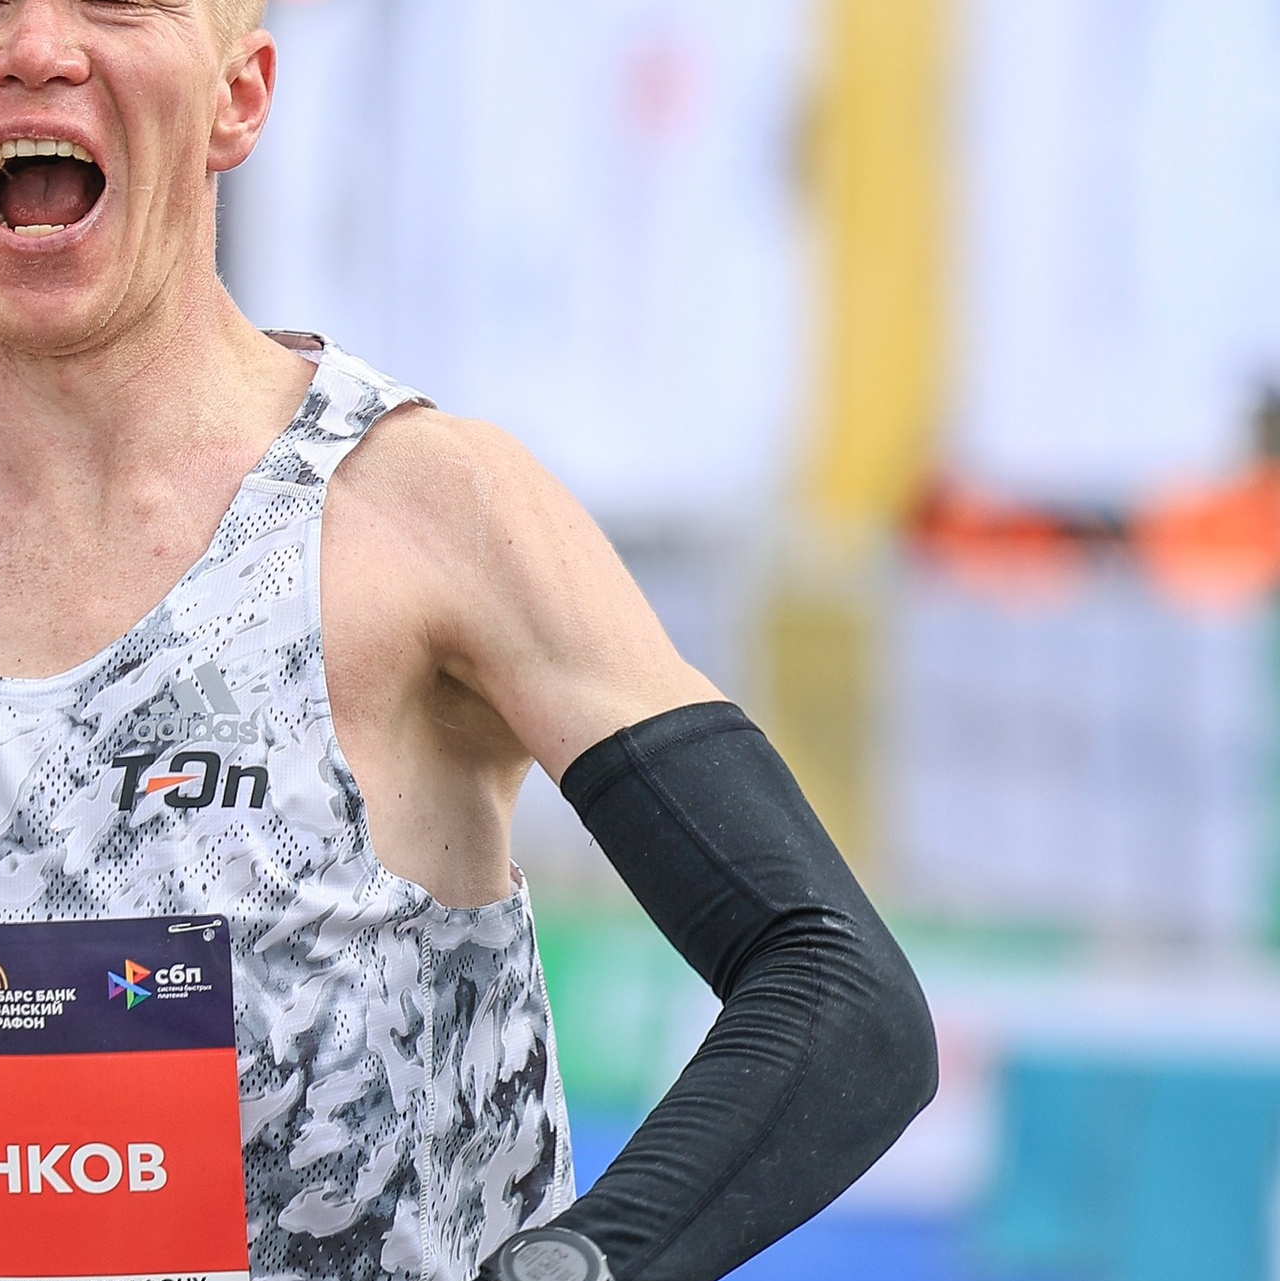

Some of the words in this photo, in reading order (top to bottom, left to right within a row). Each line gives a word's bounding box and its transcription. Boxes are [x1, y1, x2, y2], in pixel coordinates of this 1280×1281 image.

[133, 713, 260, 745] adidas
[154, 963, 202, 986] сбп
[35, 988, 77, 1002] БАНК
